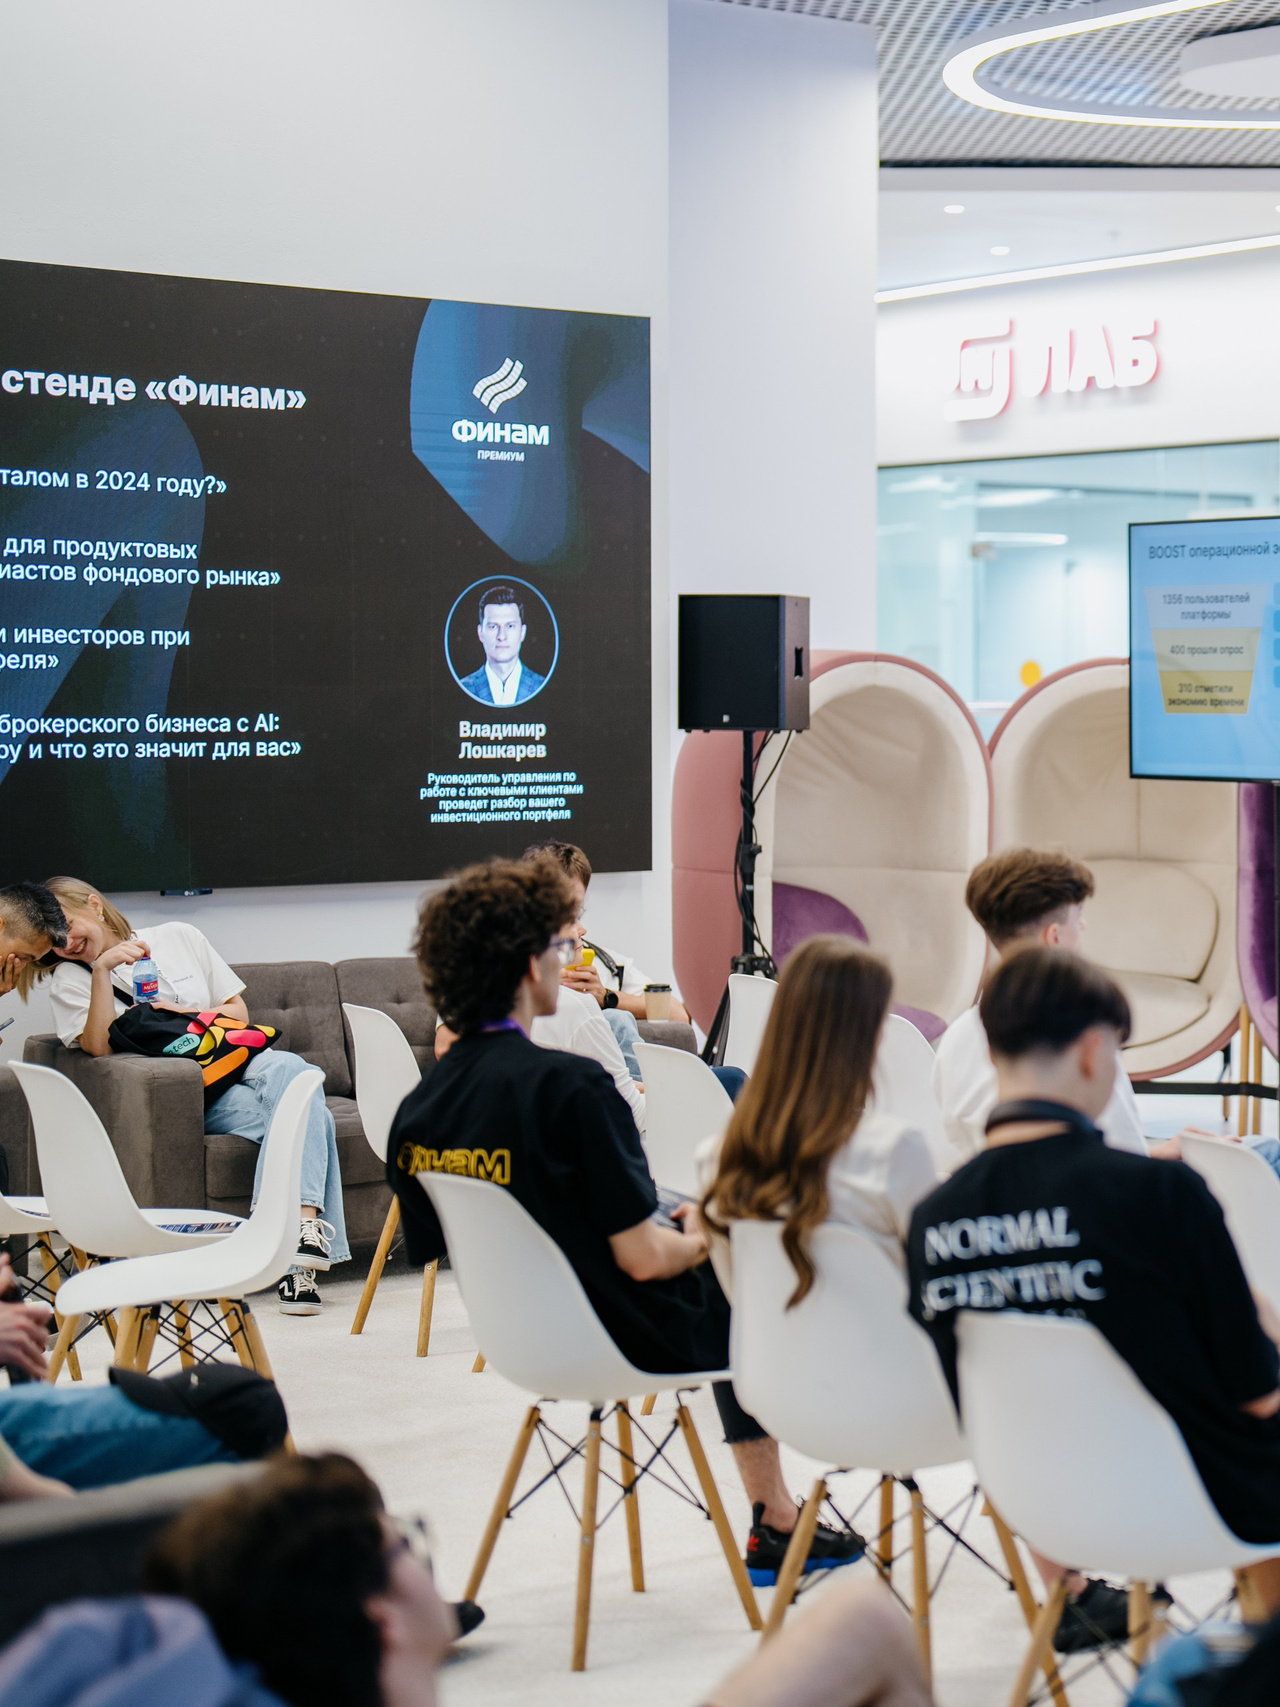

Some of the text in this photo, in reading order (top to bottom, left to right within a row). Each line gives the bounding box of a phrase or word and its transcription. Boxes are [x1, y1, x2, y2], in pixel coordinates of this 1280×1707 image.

[1023, 318, 1161, 399] ЛАБ
[1, 369, 307, 410] стенде «Финам»
[477, 450, 525, 461] ПРЕМИУМ
[0, 468, 227, 498] талом в 2024 году?»
[3, 537, 198, 561] для продуктовых
[1149, 545, 1187, 559] BOOST
[1189, 541, 1270, 560] операционной
[83, 563, 200, 586] фондового
[206, 569, 281, 589] рынка»
[1163, 594, 1183, 604] 1356
[14, 628, 145, 649] инвесторов
[151, 630, 191, 650] при
[0, 713, 140, 737] брокерского
[146, 714, 231, 733] бизнеса
[237, 717, 249, 733] с
[459, 720, 547, 741] Владимир
[29, 743, 42, 759] и
[50, 743, 87, 759] что
[93, 742, 129, 759] это
[135, 742, 207, 758] значит
[211, 741, 250, 760] для
[256, 741, 302, 757] вас»
[458, 742, 547, 762] Лошкарев
[427, 772, 577, 786] Руководитель управления по
[420, 784, 584, 799] работе с ключевыми клиентами
[439, 797, 566, 811] проведет разбор вашего
[430, 808, 572, 824] инвестиционного портфеля
